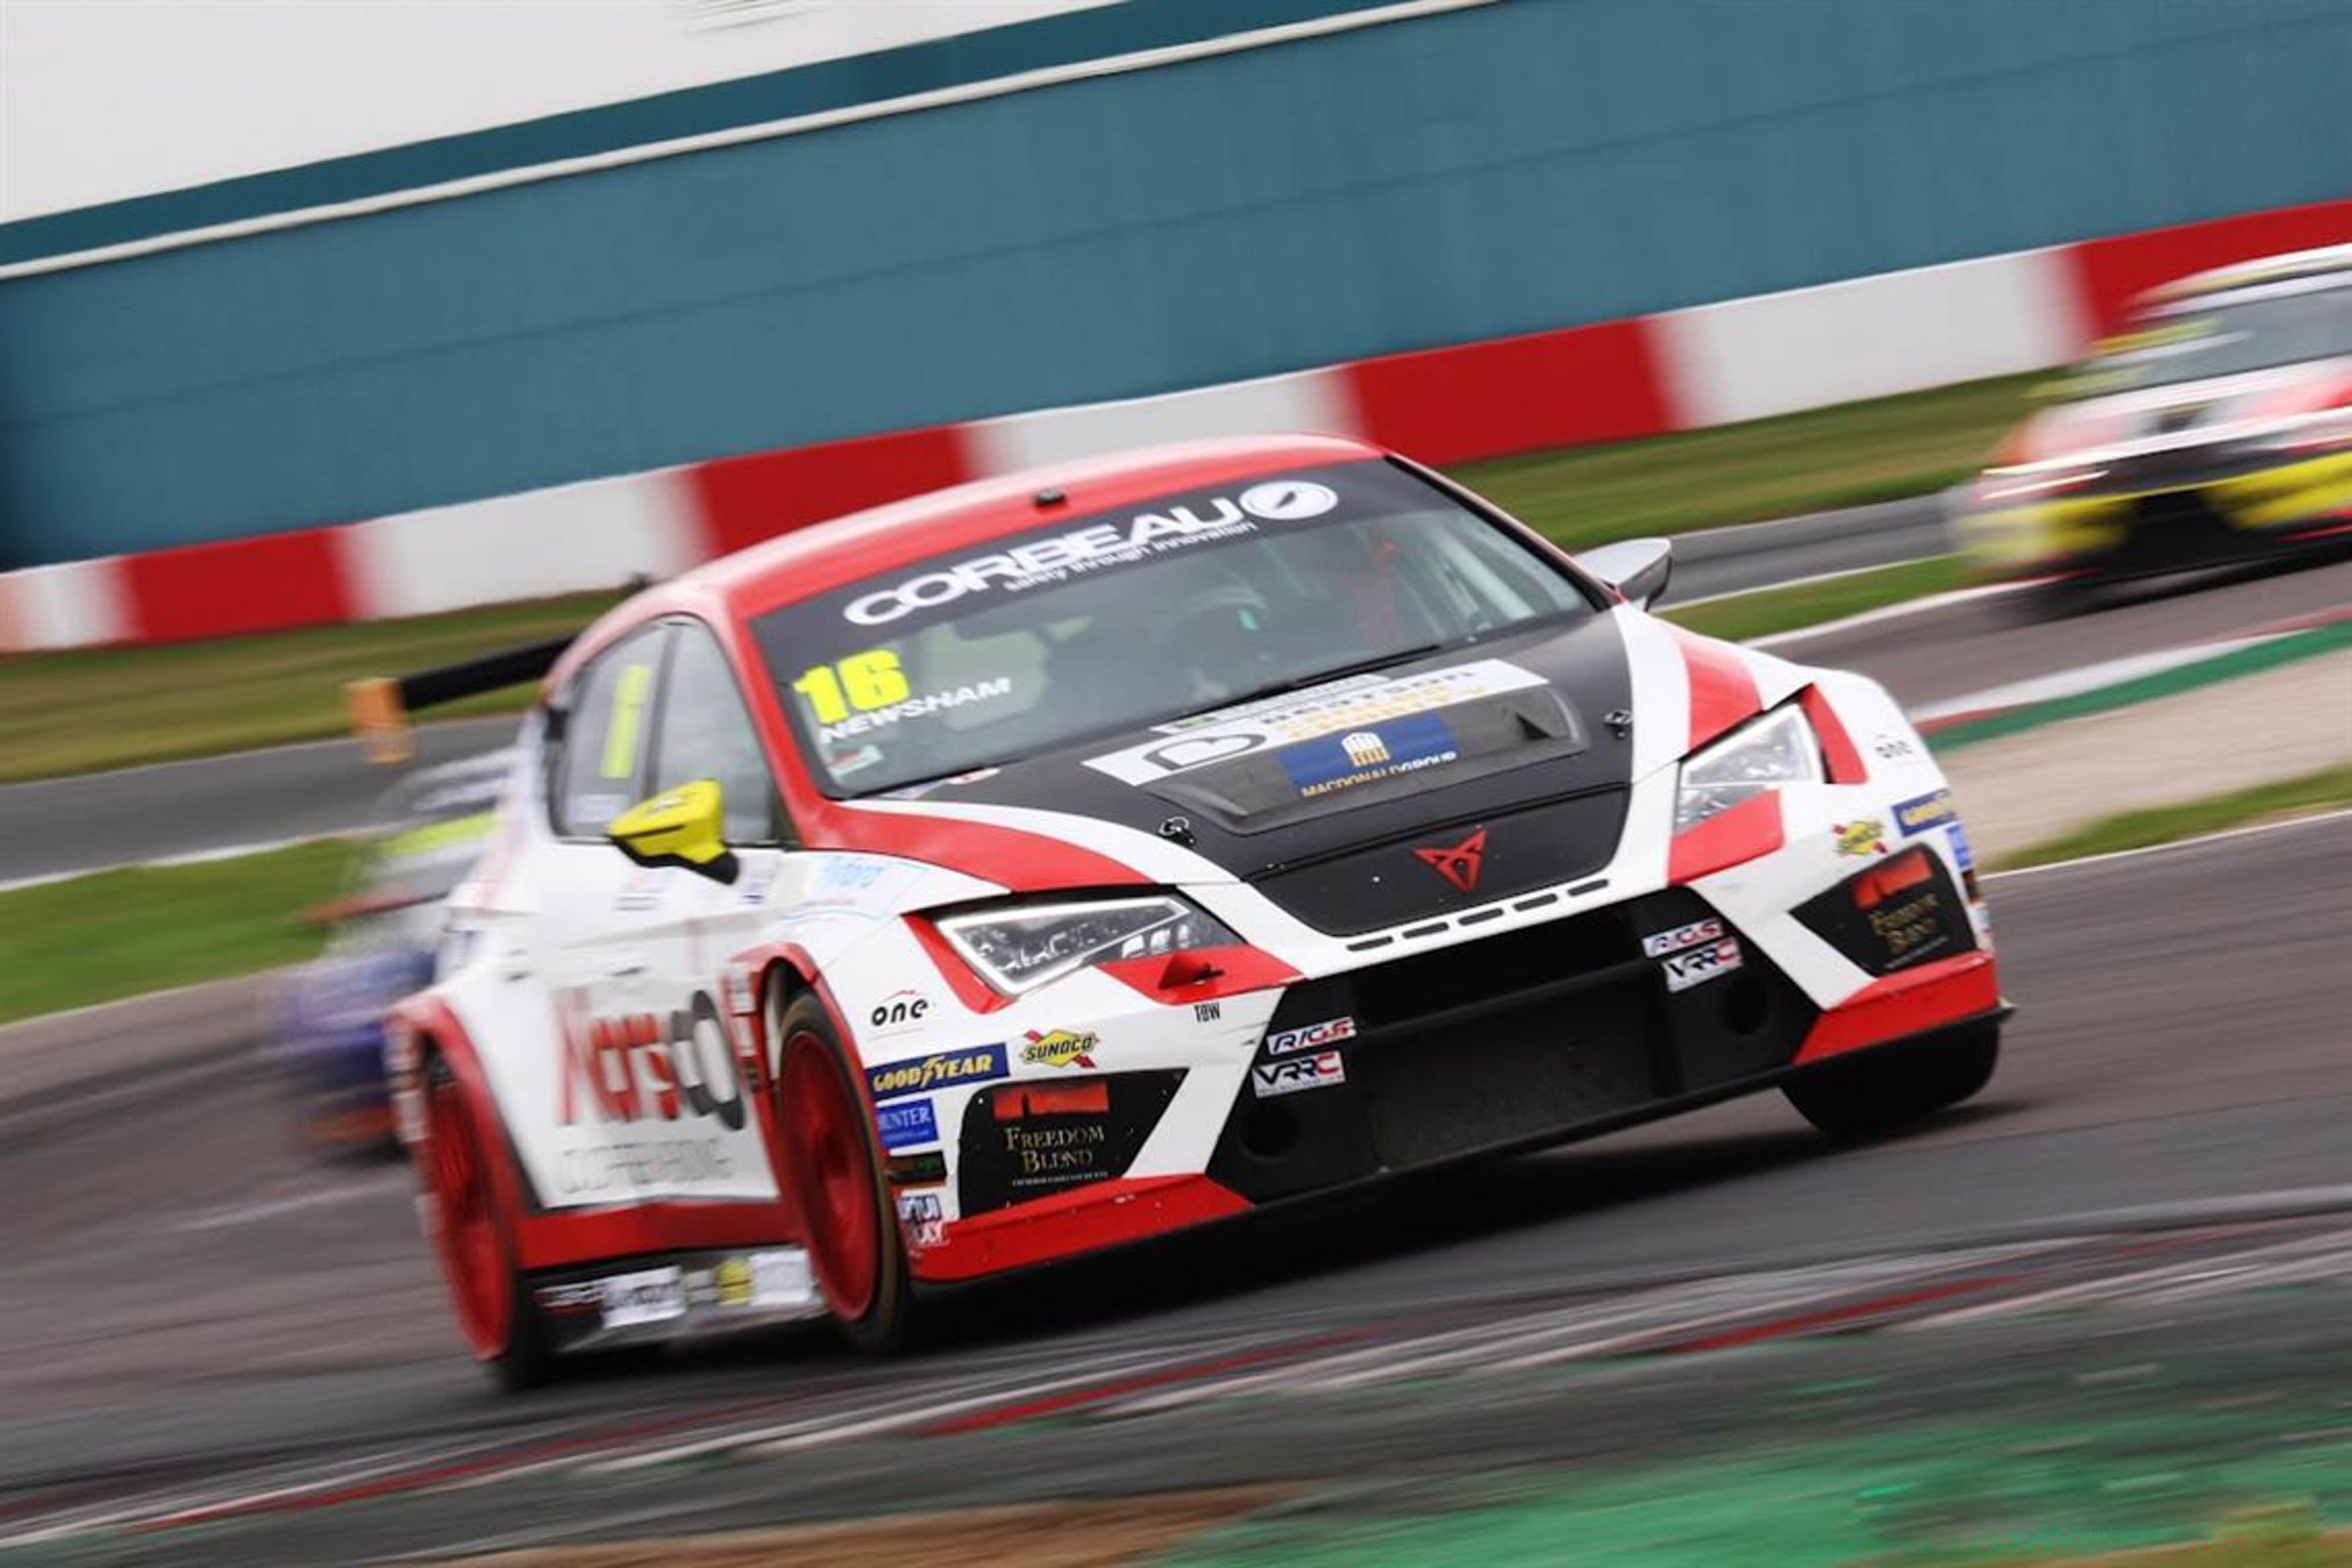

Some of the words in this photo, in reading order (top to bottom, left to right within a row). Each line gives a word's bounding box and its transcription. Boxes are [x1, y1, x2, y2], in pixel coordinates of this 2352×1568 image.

[843, 496, 1245, 626] CORBEAU
[1070, 541, 1152, 574] through
[1154, 520, 1258, 553] innovation
[793, 650, 910, 726] 16
[819, 677, 1012, 744] NEWSHAM
[871, 999, 930, 1027] one
[1194, 1003, 1221, 1022] TOW
[1026, 1037, 1093, 1061] SUNOCO
[1274, 1021, 1351, 1051] RIGS
[1257, 1053, 1338, 1085] VRRC
[1005, 1125, 1104, 1151] FREEDOM
[1022, 1149, 1094, 1174] BLEND
